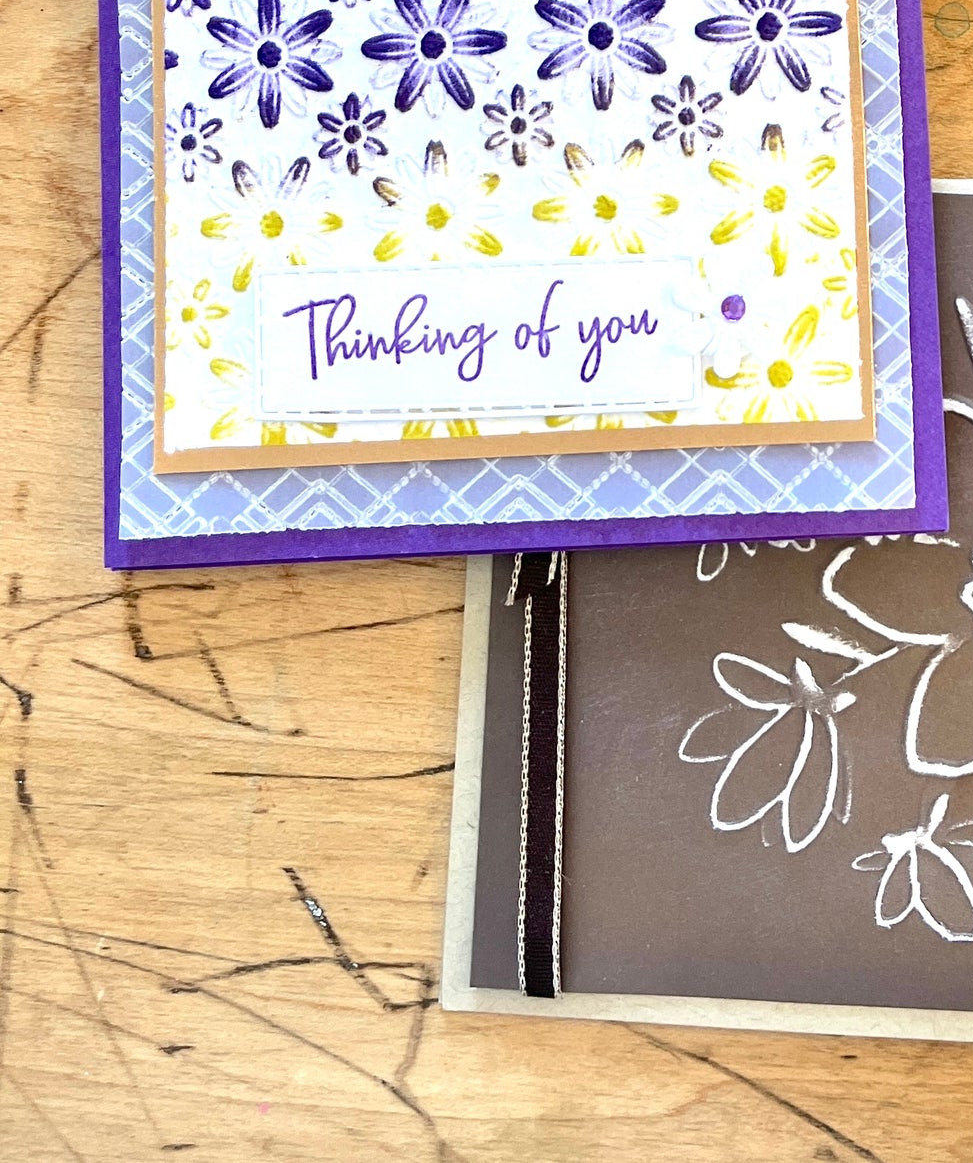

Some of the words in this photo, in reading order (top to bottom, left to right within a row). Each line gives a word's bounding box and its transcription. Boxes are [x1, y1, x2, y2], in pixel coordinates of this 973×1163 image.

[282, 293, 499, 382] Thinking
[514, 279, 565, 358] of
[577, 308, 659, 383] you
